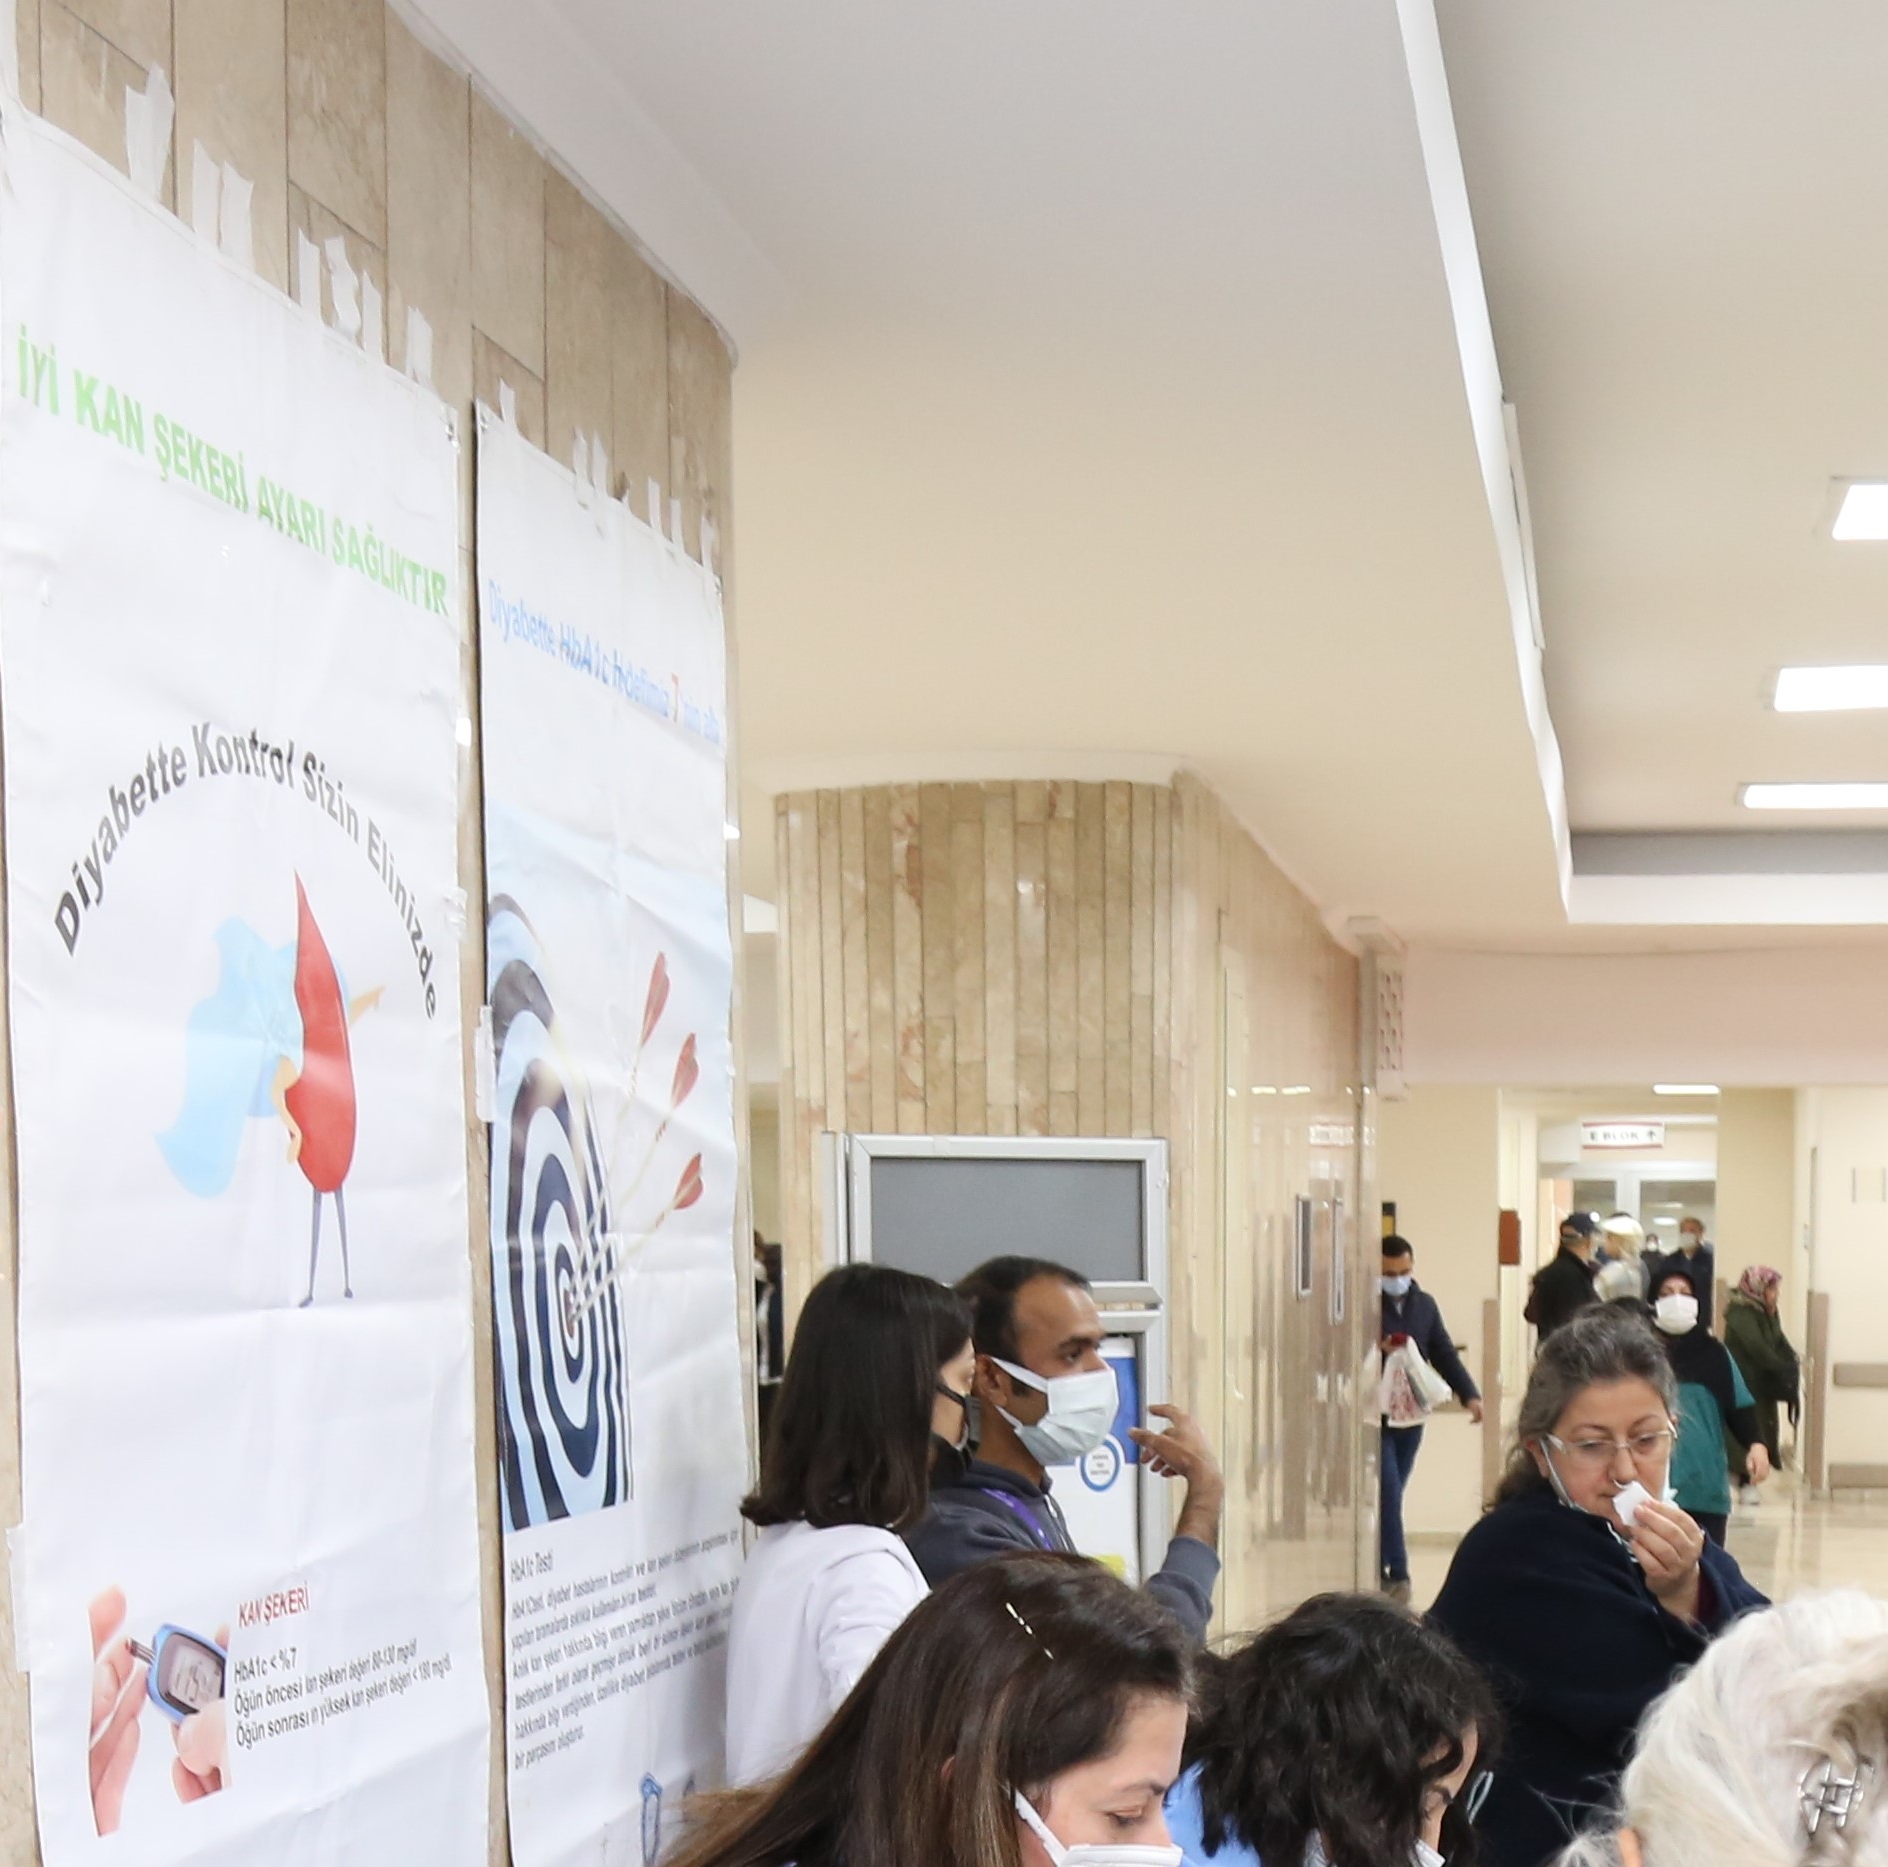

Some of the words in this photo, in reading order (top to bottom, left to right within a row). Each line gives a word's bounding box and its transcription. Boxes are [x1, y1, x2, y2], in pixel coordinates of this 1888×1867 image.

[17, 323, 60, 416] İYİ
[73, 368, 146, 457] KAN
[152, 412, 251, 514] ŞEKERİ
[256, 475, 327, 556] AYARI
[331, 516, 450, 617] SAĞLIKTIR
[54, 740, 187, 958] Diyabette
[191, 721, 295, 790] Kontrol
[302, 751, 360, 845] Sizin
[367, 816, 437, 1020] Elinizde
[238, 1600, 262, 1628] KAN
[264, 1581, 310, 1626] ŞEKERİ
[234, 1655, 268, 1684] HbA1c
[234, 1688, 263, 1718] Öğün
[266, 1677, 303, 1707] öncesi
[236, 1718, 266, 1749] Öğün
[268, 1710, 309, 1737] sonrası
[320, 1694, 351, 1725] yüksek
